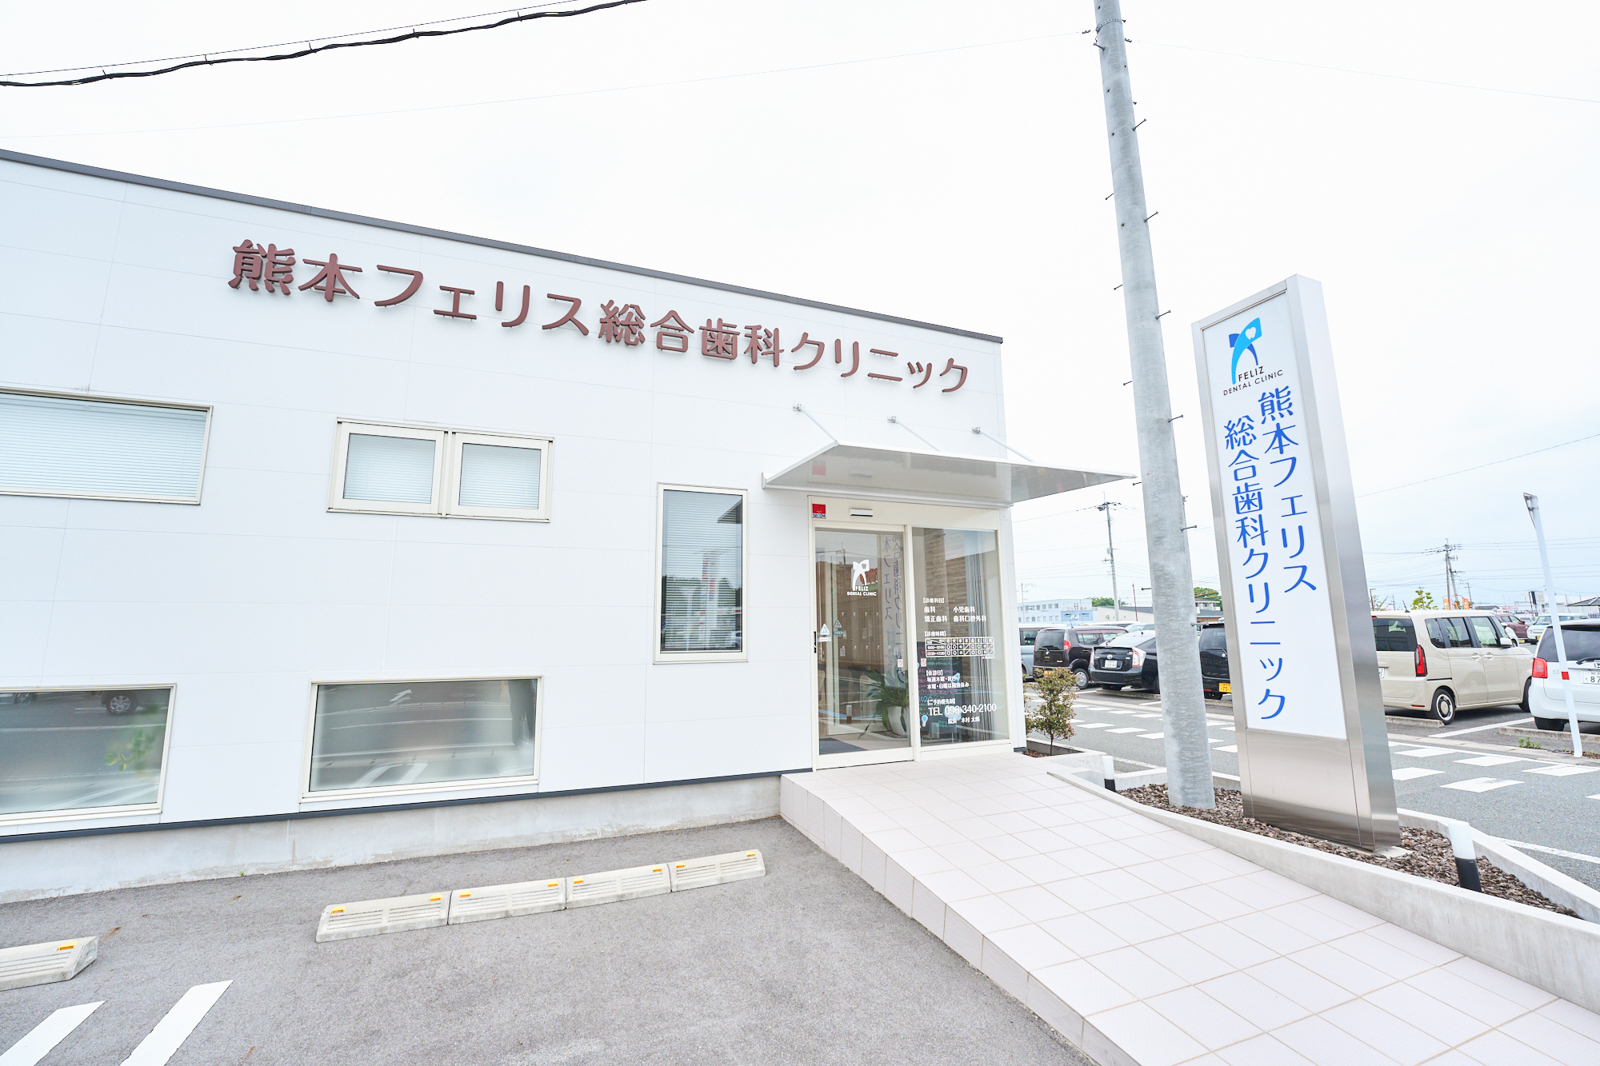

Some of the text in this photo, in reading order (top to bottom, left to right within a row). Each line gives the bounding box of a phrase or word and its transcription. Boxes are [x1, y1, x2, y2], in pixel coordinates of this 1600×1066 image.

[228, 239, 968, 394] 熊本フェリス総合歯科クリニック
[1223, 369, 1284, 396] DENTAL CLINIC
[1238, 366, 1264, 382] FELIZ
[1258, 385, 1317, 594] 熊本フェリス
[1223, 414, 1286, 720] 総合歯科クリニック
[928, 703, 997, 717] TEL 096-340-2100
